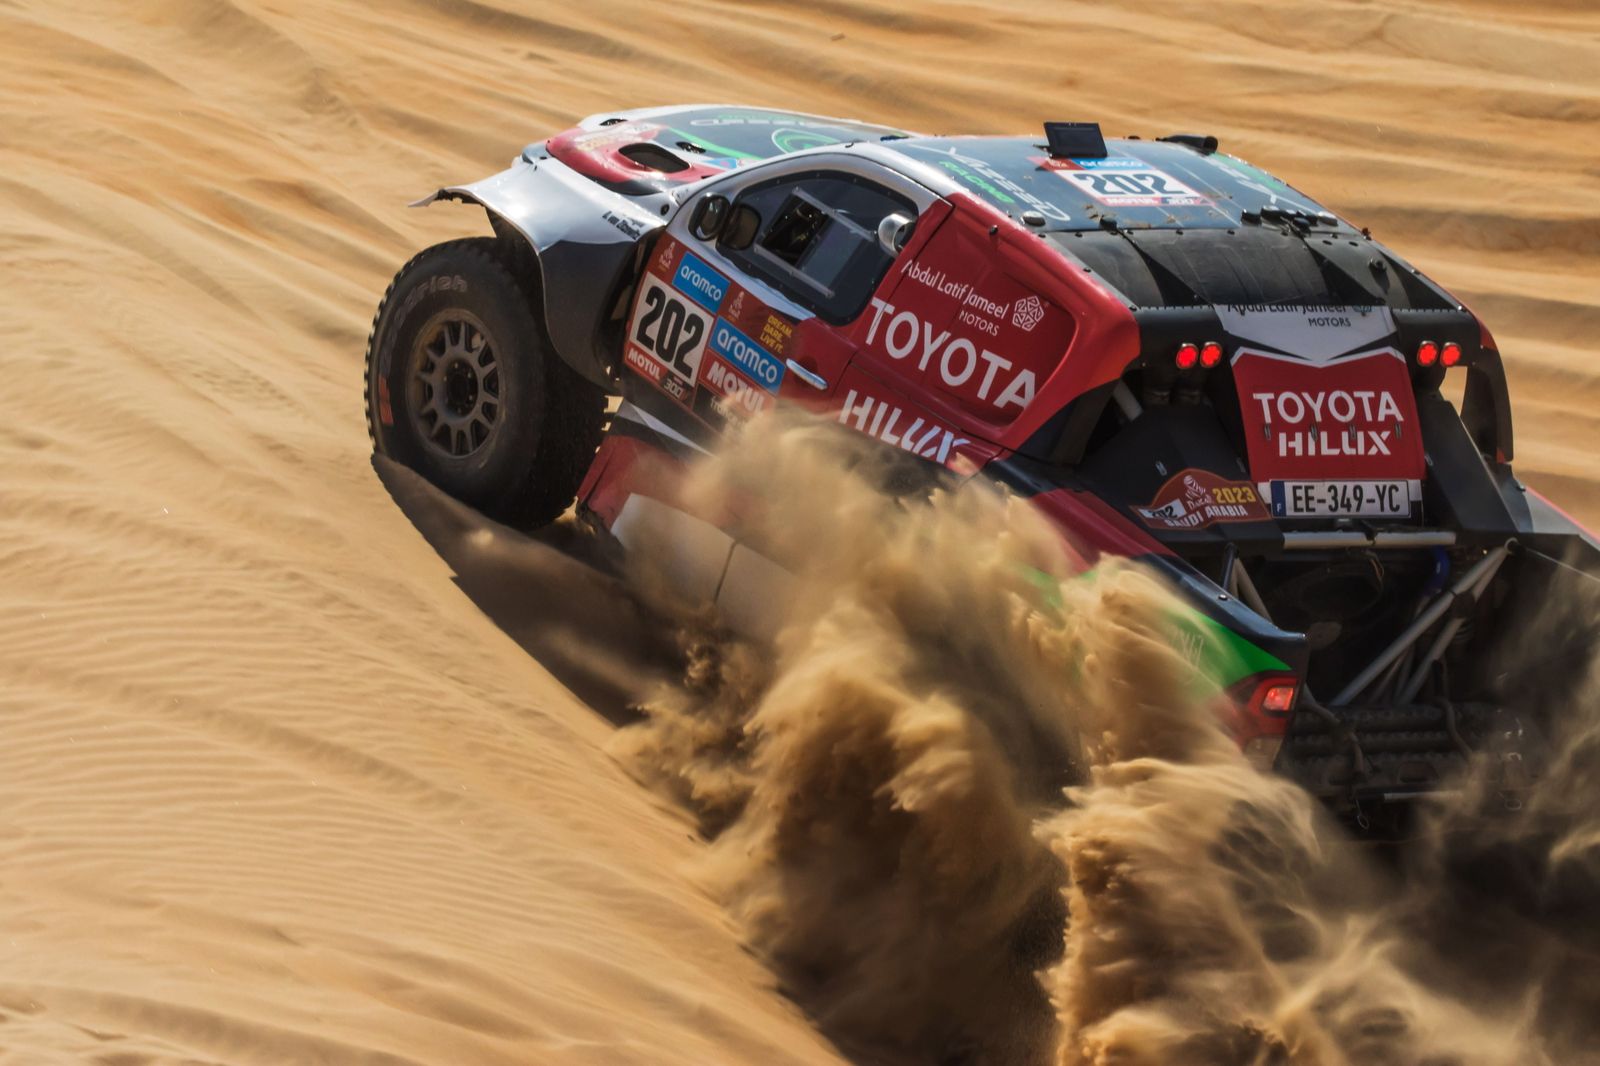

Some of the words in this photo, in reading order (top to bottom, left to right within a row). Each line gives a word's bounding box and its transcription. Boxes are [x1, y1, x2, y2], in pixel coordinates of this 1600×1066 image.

[1073, 173, 1188, 195] 202
[680, 265, 723, 302] aramco
[901, 258, 938, 287] Abdul
[937, 273, 967, 298] Latif
[964, 289, 1010, 320] Jameel
[636, 285, 705, 380] 202
[959, 310, 1000, 337] MOTORS
[1308, 317, 1352, 327] MOTORS
[628, 348, 661, 381] MOTUL
[716, 328, 778, 384] aramco
[865, 296, 1037, 410] TOYOTA
[1252, 390, 1405, 424] TOYOTA
[838, 389, 972, 465] HILUX
[1278, 430, 1392, 457] HILUX
[1212, 486, 1257, 504] 2023
[1292, 484, 1400, 513] EE-349-YC
[1164, 511, 1204, 528] SAUDI
[1205, 504, 1249, 519] ARABIA
